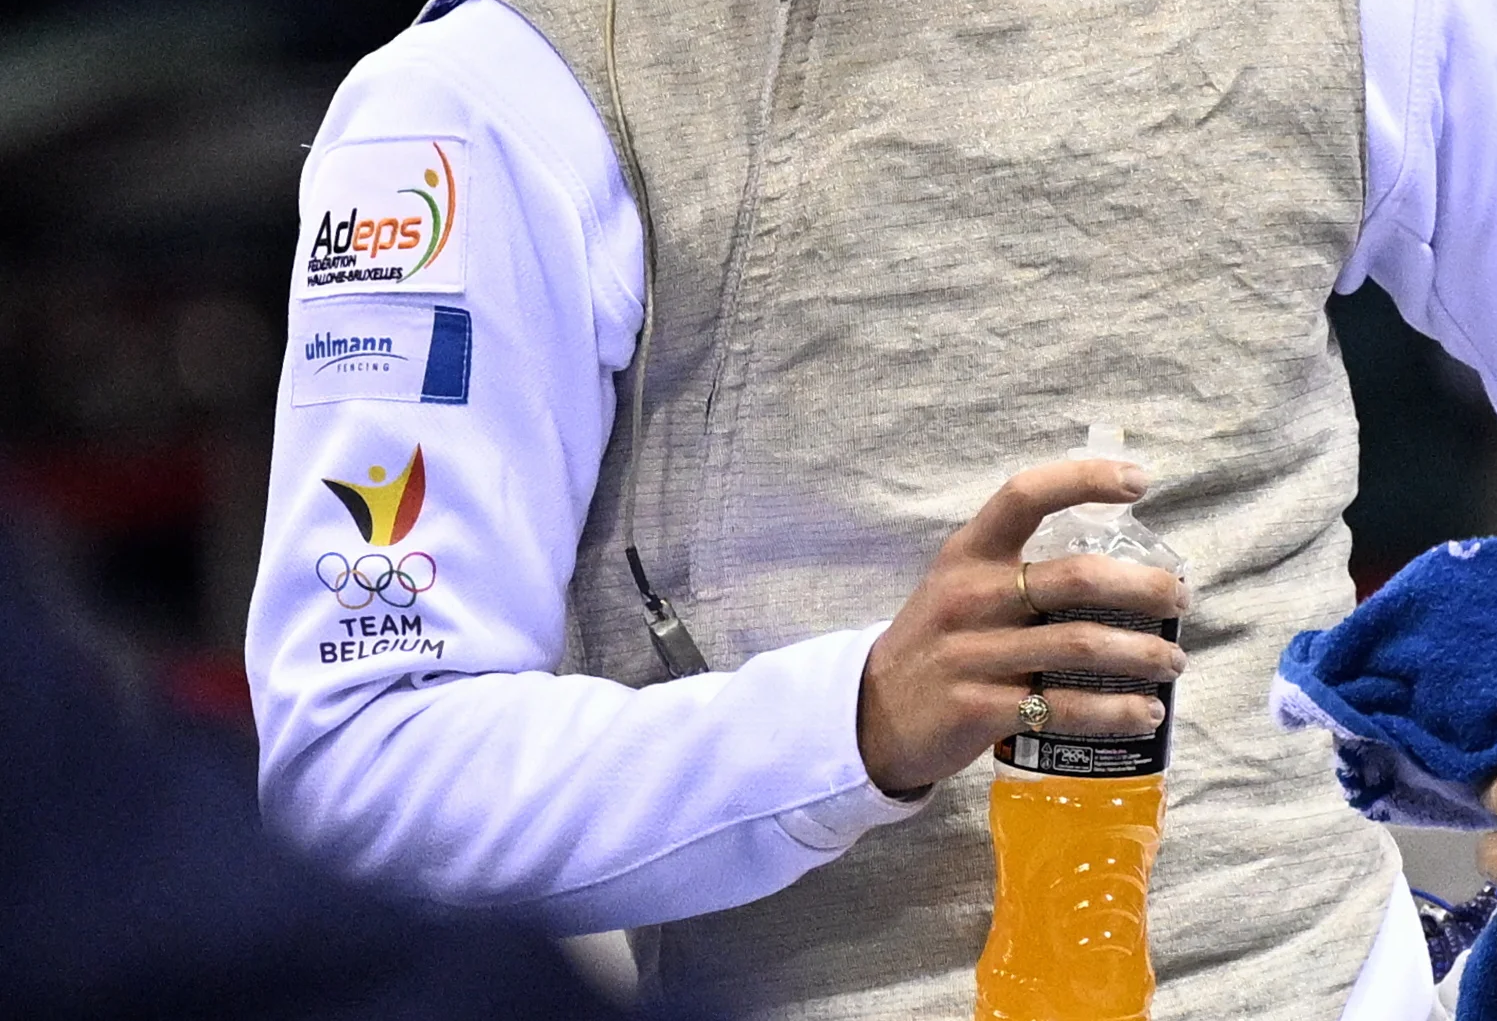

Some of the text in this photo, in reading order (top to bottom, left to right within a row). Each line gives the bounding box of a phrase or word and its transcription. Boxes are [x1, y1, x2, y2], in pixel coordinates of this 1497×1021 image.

[311, 208, 422, 258] Adeps
[305, 332, 392, 361] uhlmann
[337, 363, 390, 373] FENCING
[340, 614, 422, 637] TEAM
[320, 639, 445, 663] BELGIUM
